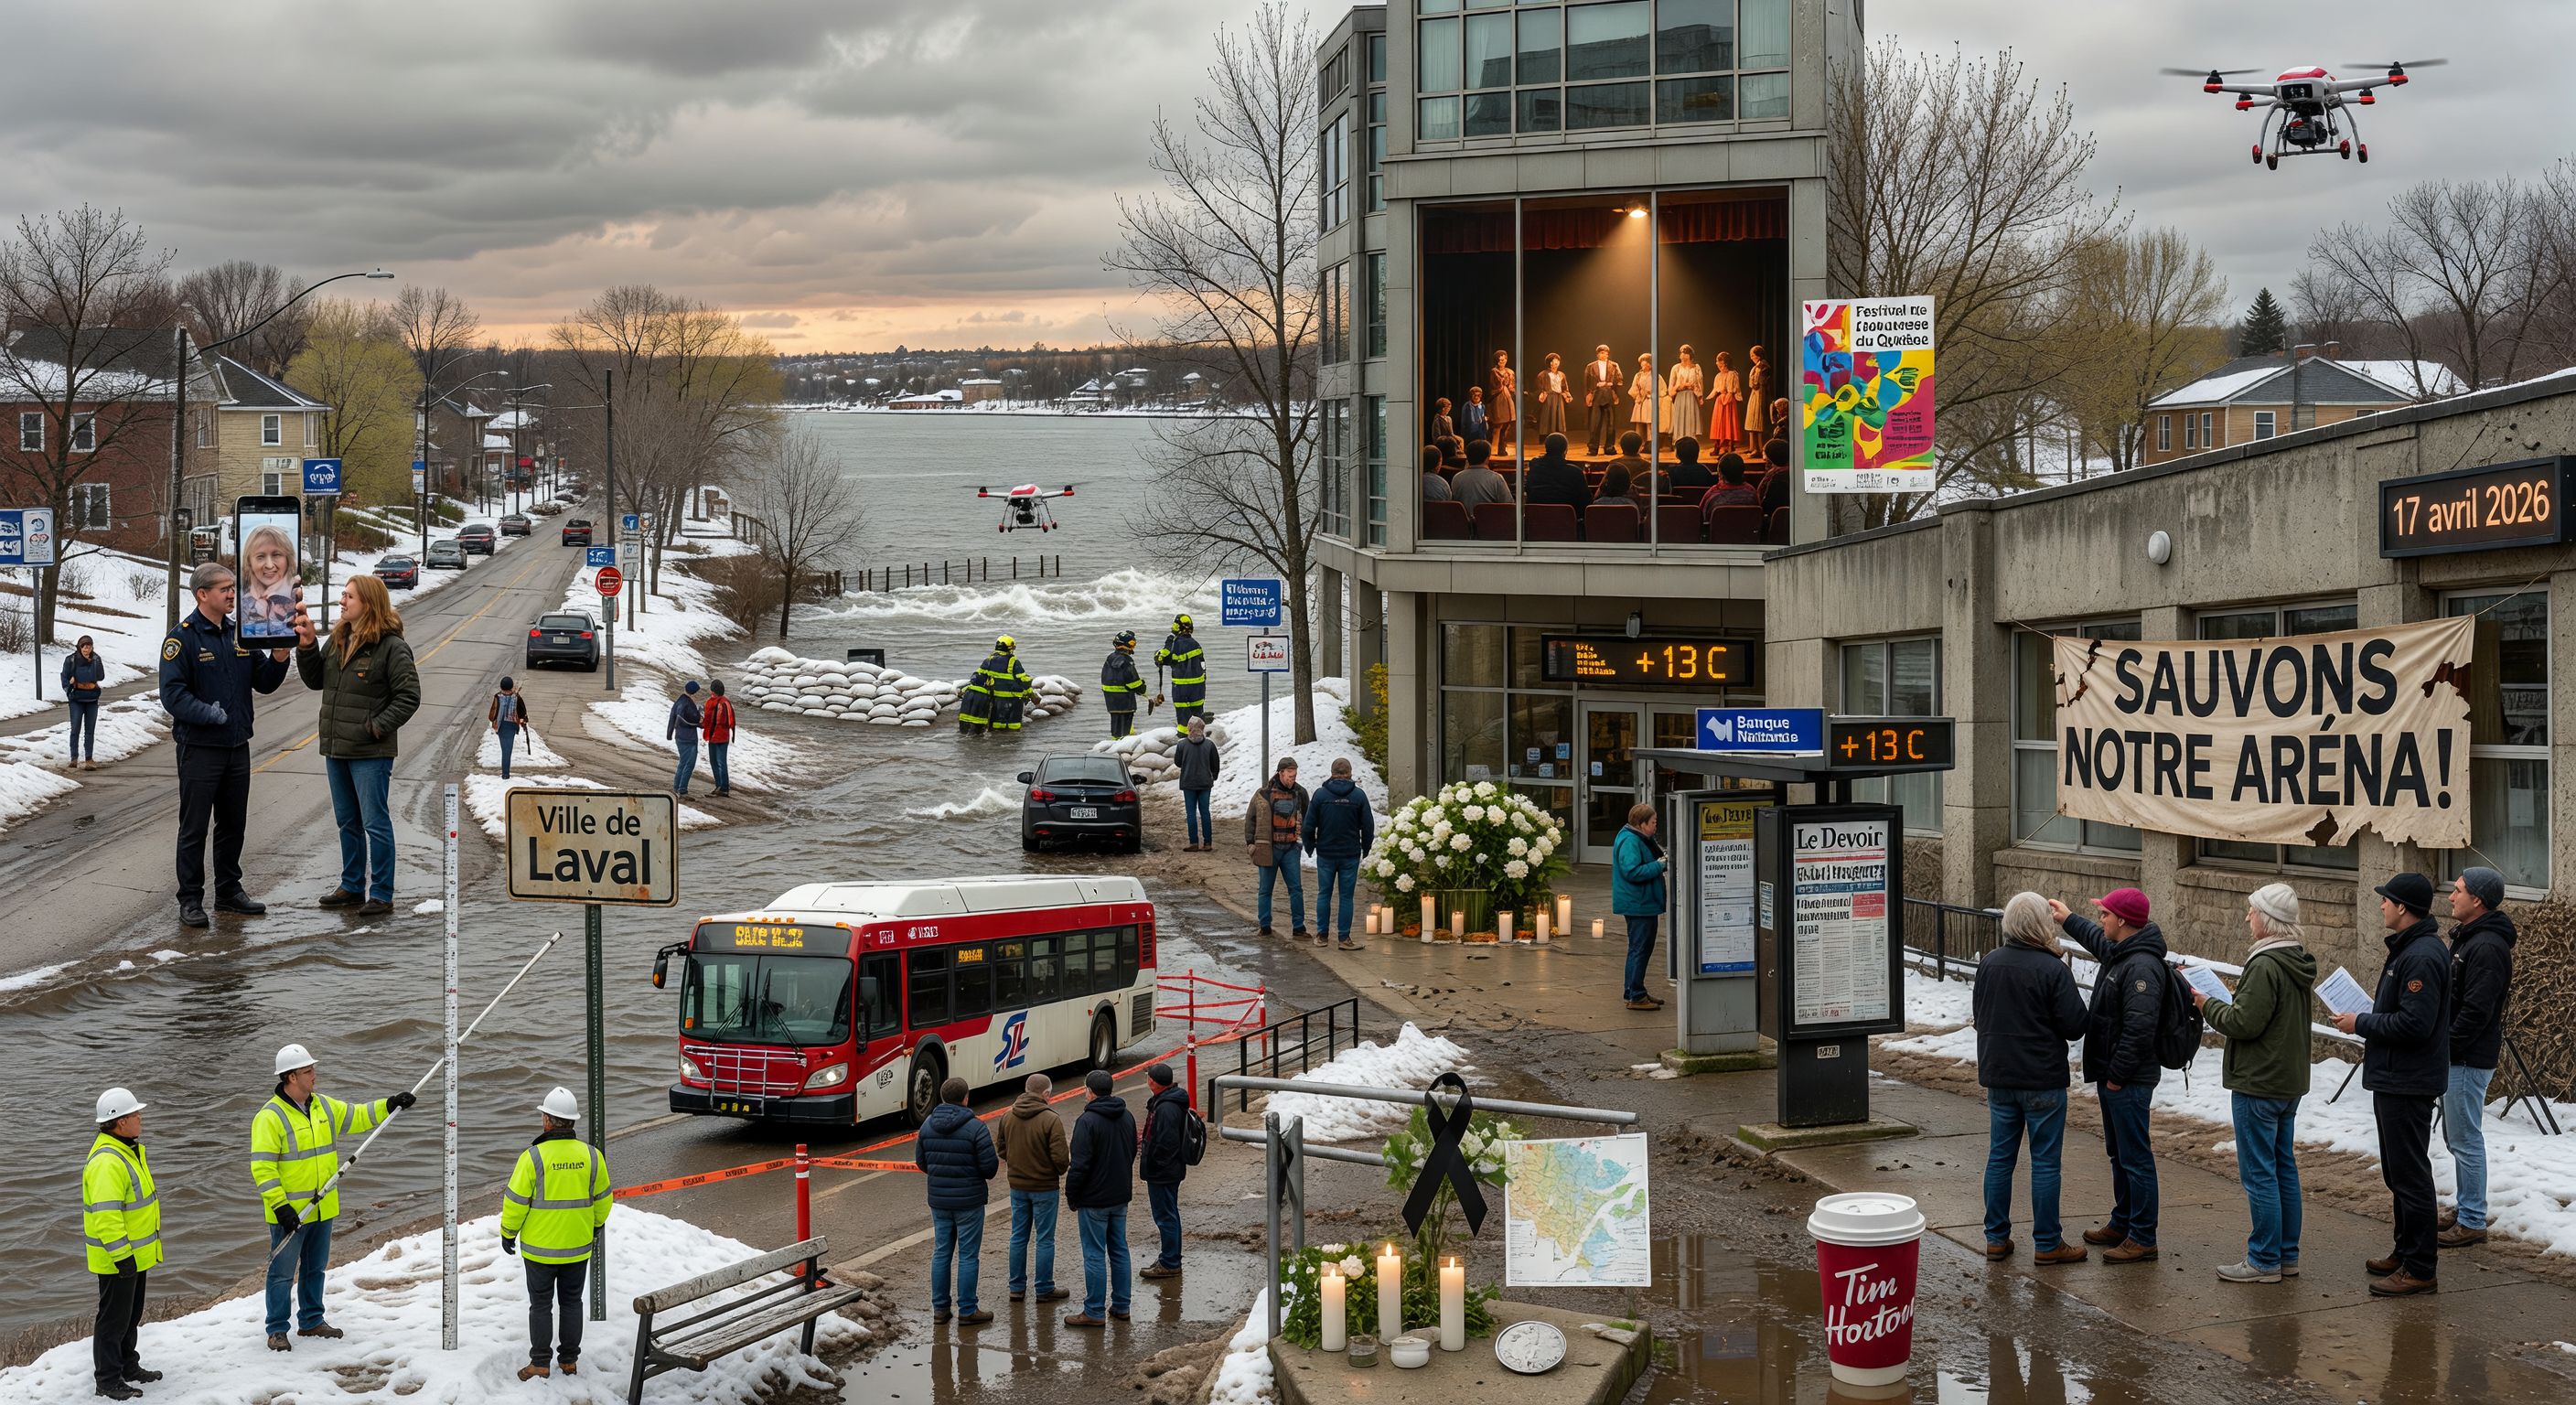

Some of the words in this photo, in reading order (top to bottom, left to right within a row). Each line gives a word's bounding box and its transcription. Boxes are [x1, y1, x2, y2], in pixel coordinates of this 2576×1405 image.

[2393, 496, 2420, 536] 17
[2428, 488, 2478, 533] avril
[2485, 479, 2550, 527] 2026
[2114, 638, 2398, 718] SAUVONS
[2065, 725, 2214, 801] NOTRE
[2230, 713, 2453, 810] ARÉNA!
[537, 805, 596, 835] Ville
[606, 807, 641, 837] de
[1795, 828, 1819, 850] Le
[1820, 825, 1884, 849] Devoir
[529, 836, 651, 885] Laval
[1834, 1262, 1898, 1308] Tim
